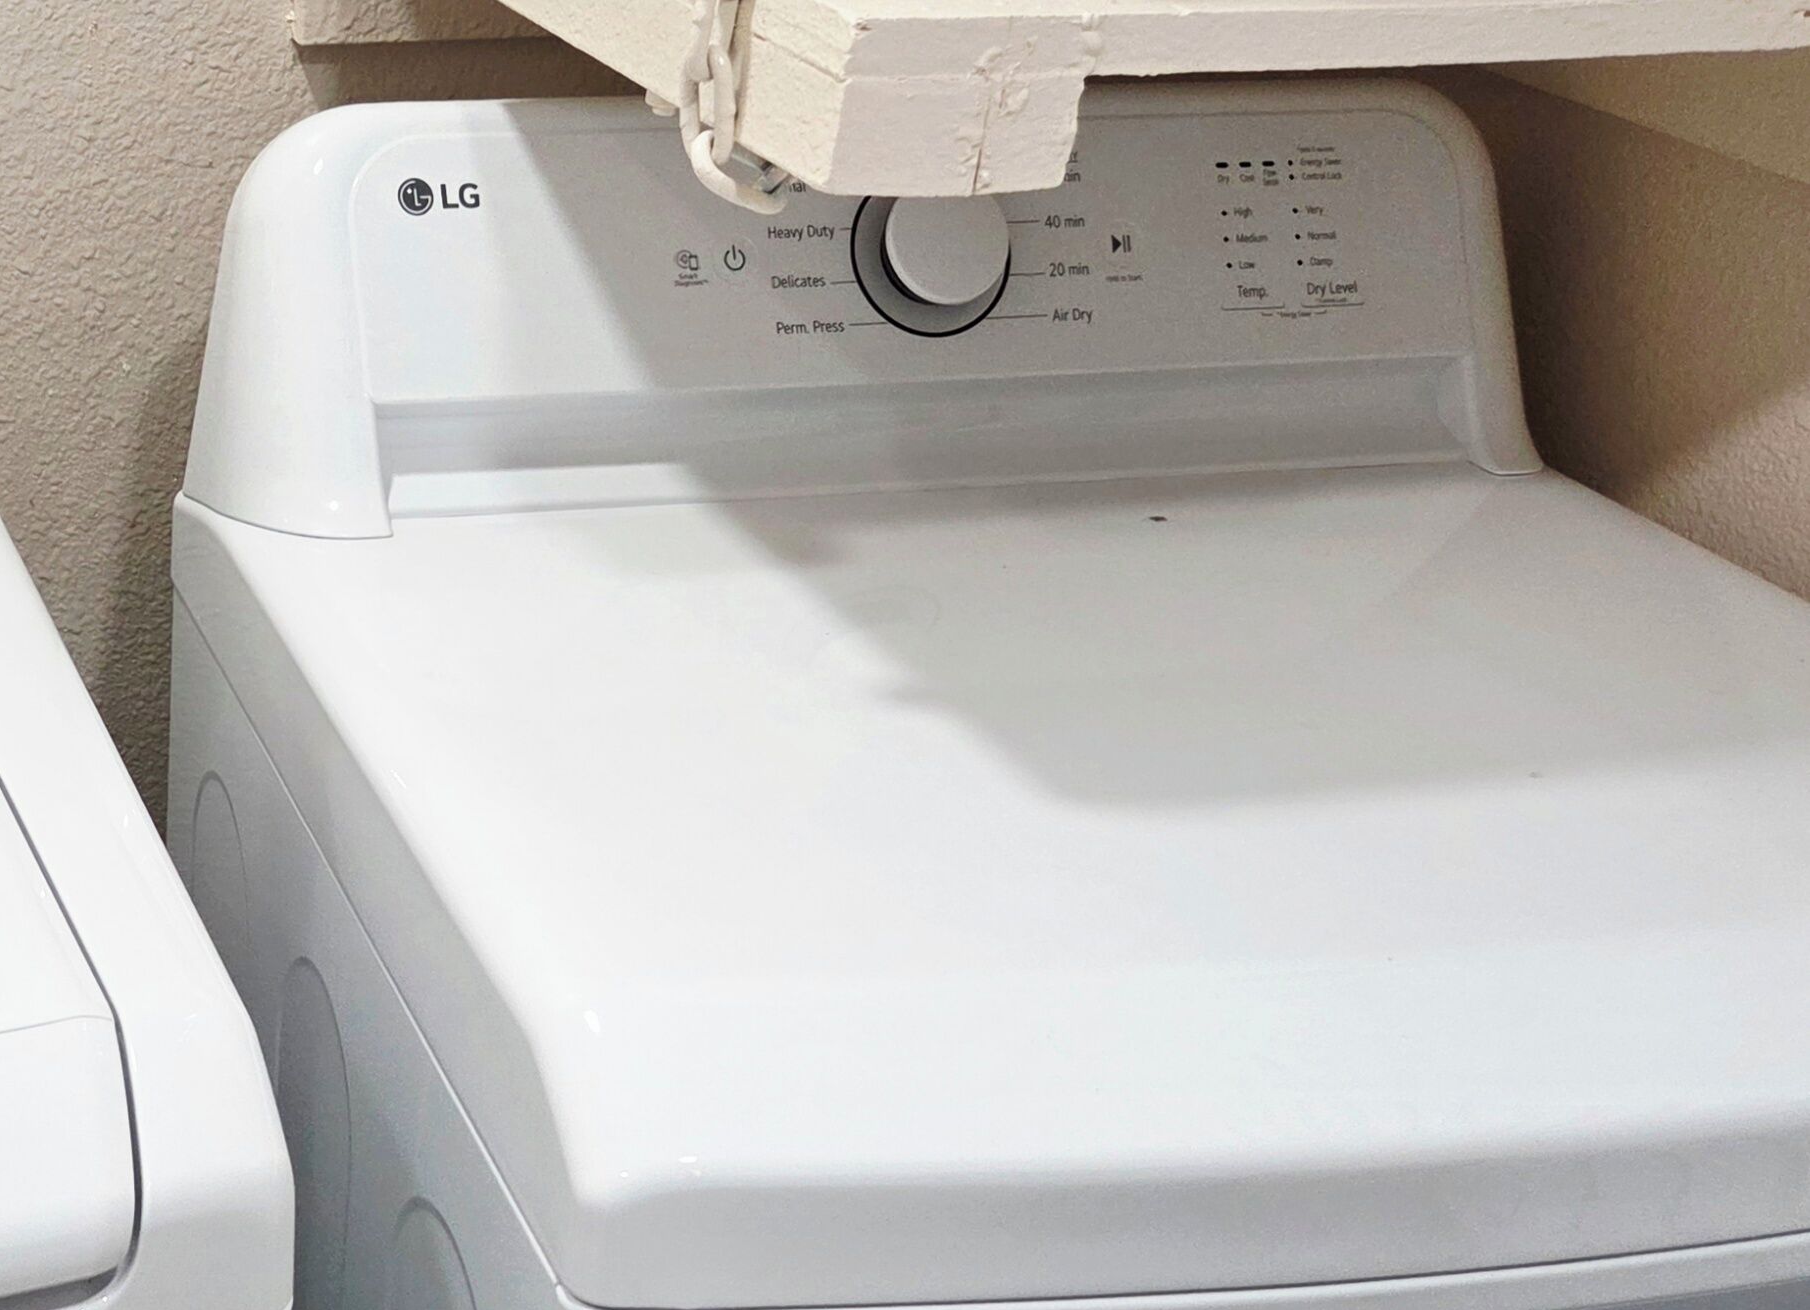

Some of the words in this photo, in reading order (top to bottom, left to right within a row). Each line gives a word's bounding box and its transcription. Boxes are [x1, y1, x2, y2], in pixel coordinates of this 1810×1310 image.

[440, 183, 480, 209] LG
[1044, 214, 1061, 229] 40
[1063, 214, 1086, 228] min
[767, 225, 804, 242] Heavy
[806, 224, 835, 241] Duty
[1048, 262, 1066, 277] 20
[1067, 262, 1090, 276] min
[771, 275, 827, 289] Delicates
[1306, 281, 1326, 298] Dry
[1328, 280, 1358, 295] Level
[1236, 284, 1269, 300] Temp.
[1052, 309, 1069, 323] Air
[1072, 307, 1093, 324] Dry
[775, 321, 810, 335] Perm.
[812, 320, 846, 334] Press
